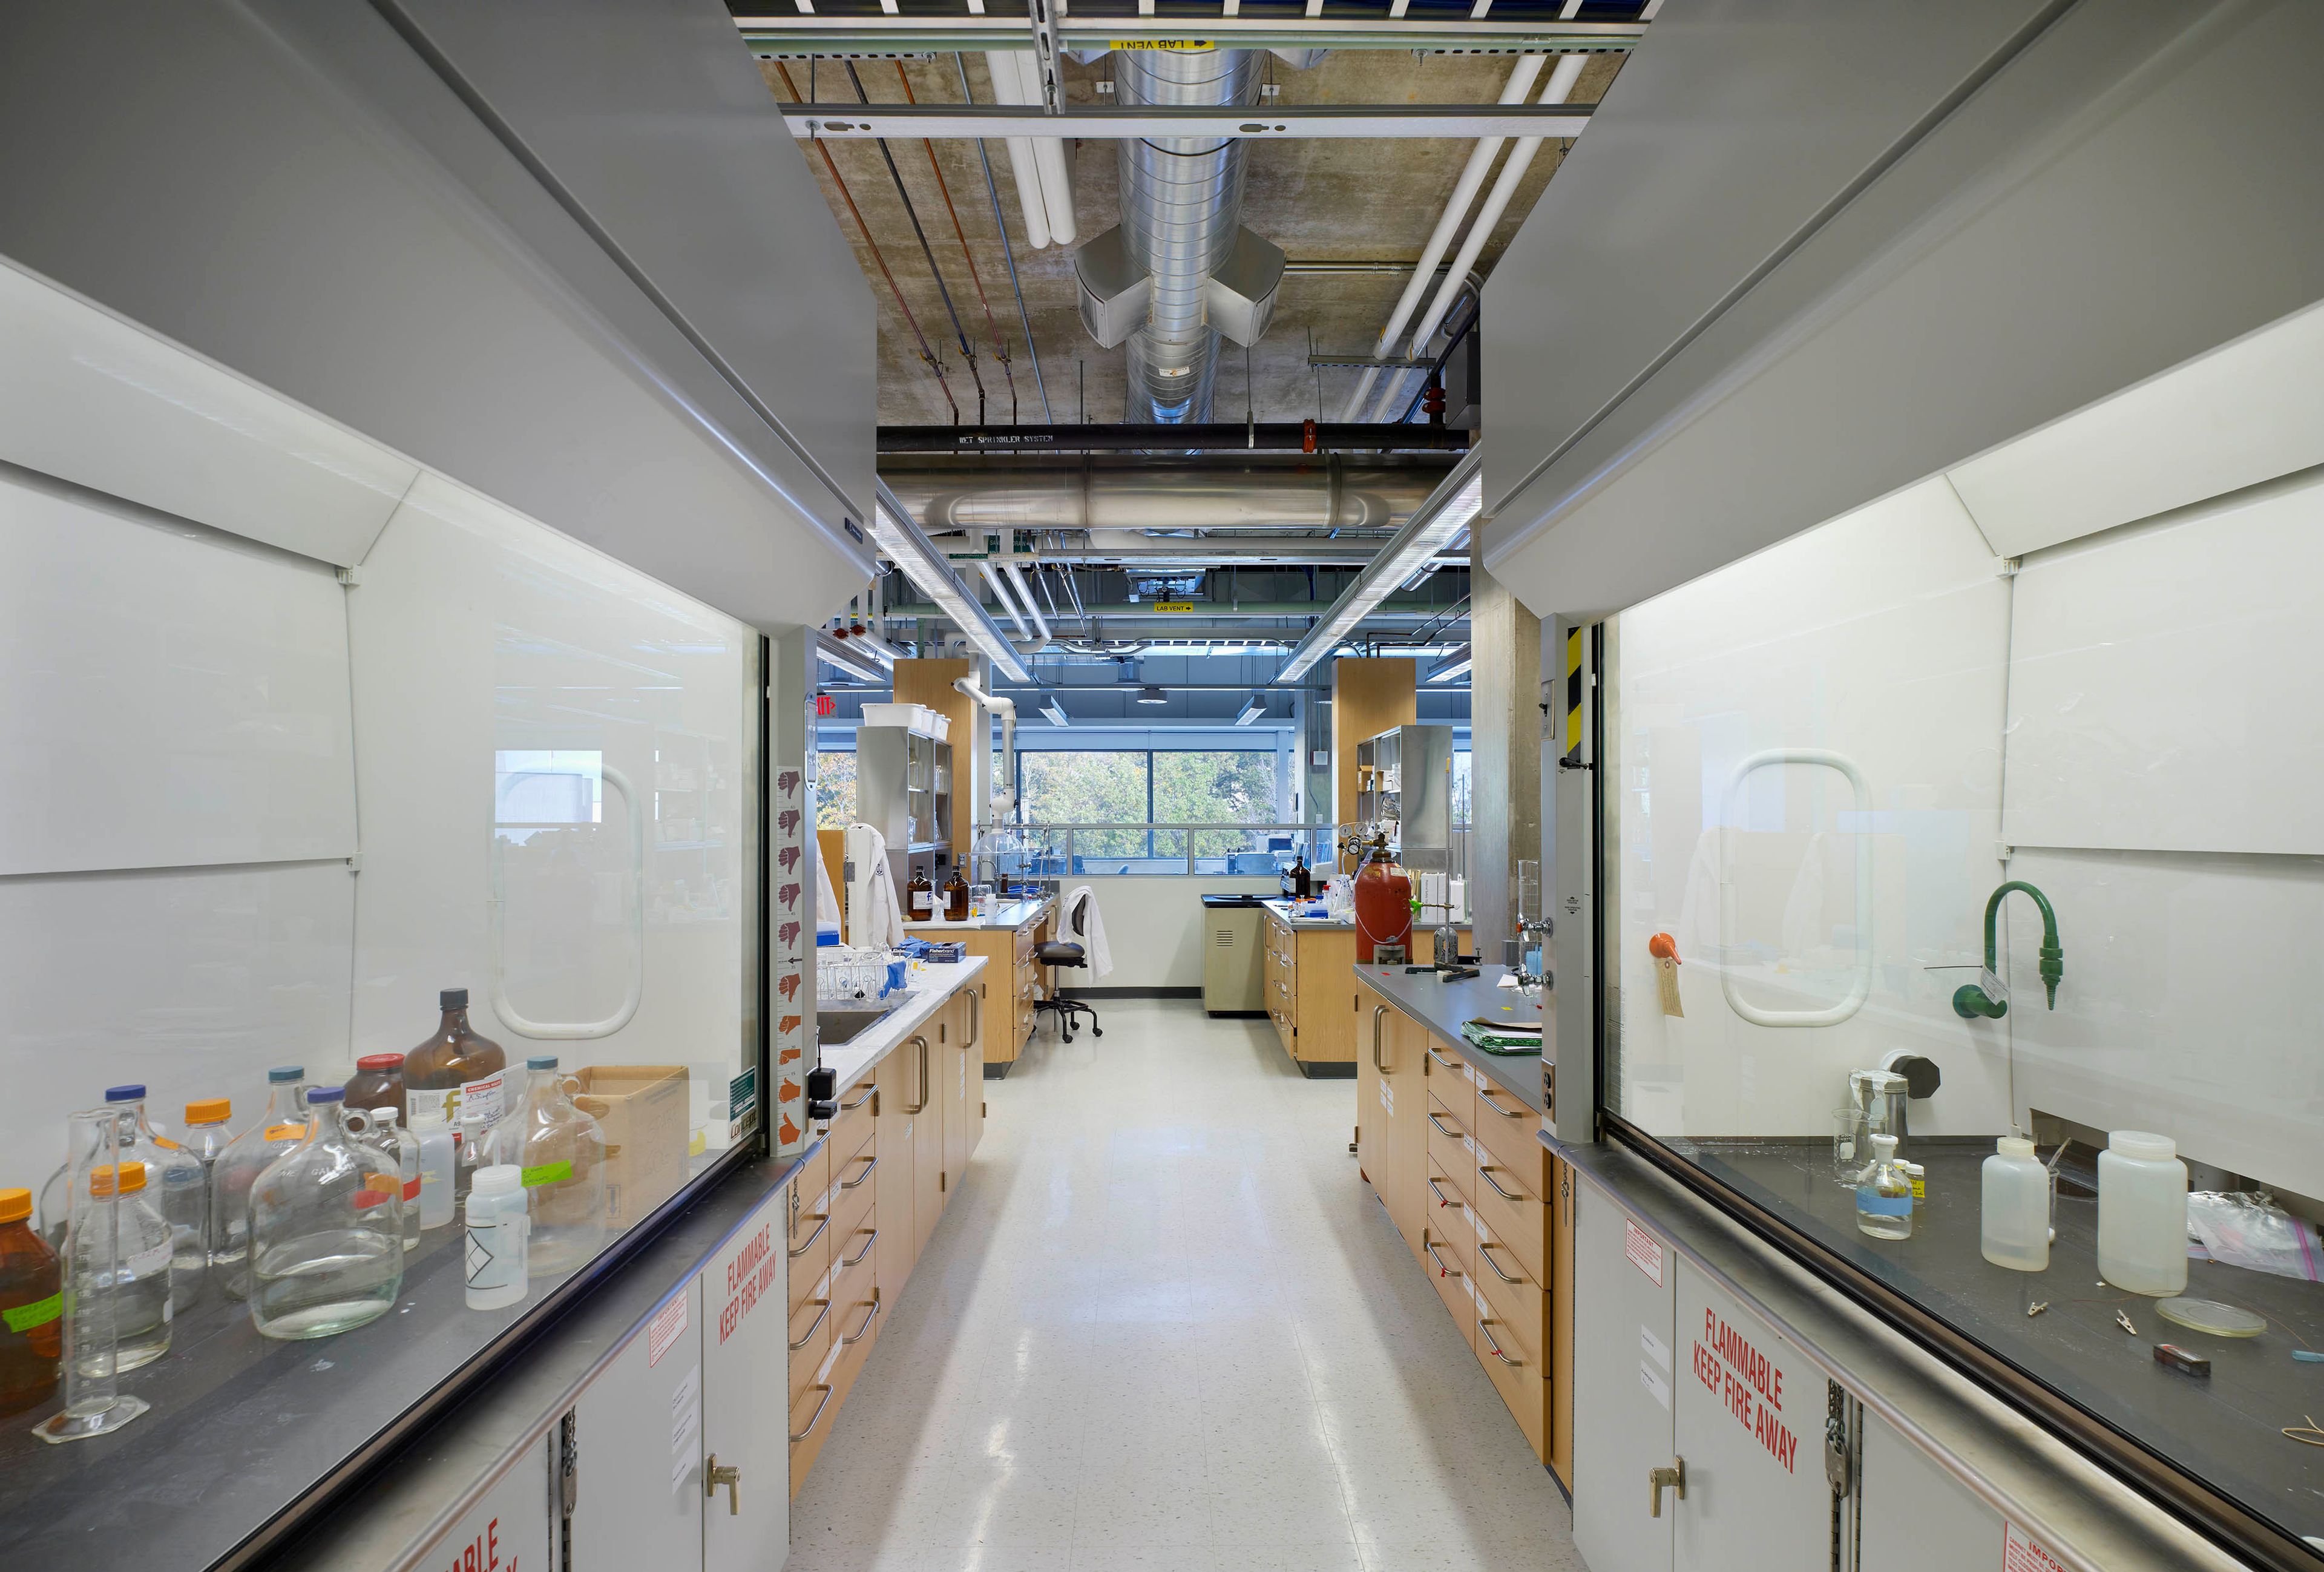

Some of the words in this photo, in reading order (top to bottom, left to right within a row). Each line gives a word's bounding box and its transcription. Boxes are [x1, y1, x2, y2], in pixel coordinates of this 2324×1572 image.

[1158, 40, 1184, 48] LAB
[720, 1295, 739, 1346] KEEP
[741, 1274, 757, 1320] FIRE
[758, 1250, 776, 1298] AWAY
[727, 1222, 770, 1297] FLAMMABLE
[1694, 1340, 1721, 1395] KEEP
[1725, 1370, 1752, 1432] FIRE
[1755, 1403, 1797, 1475] AWAY
[1705, 1307, 1782, 1412] FLAMMABLE
